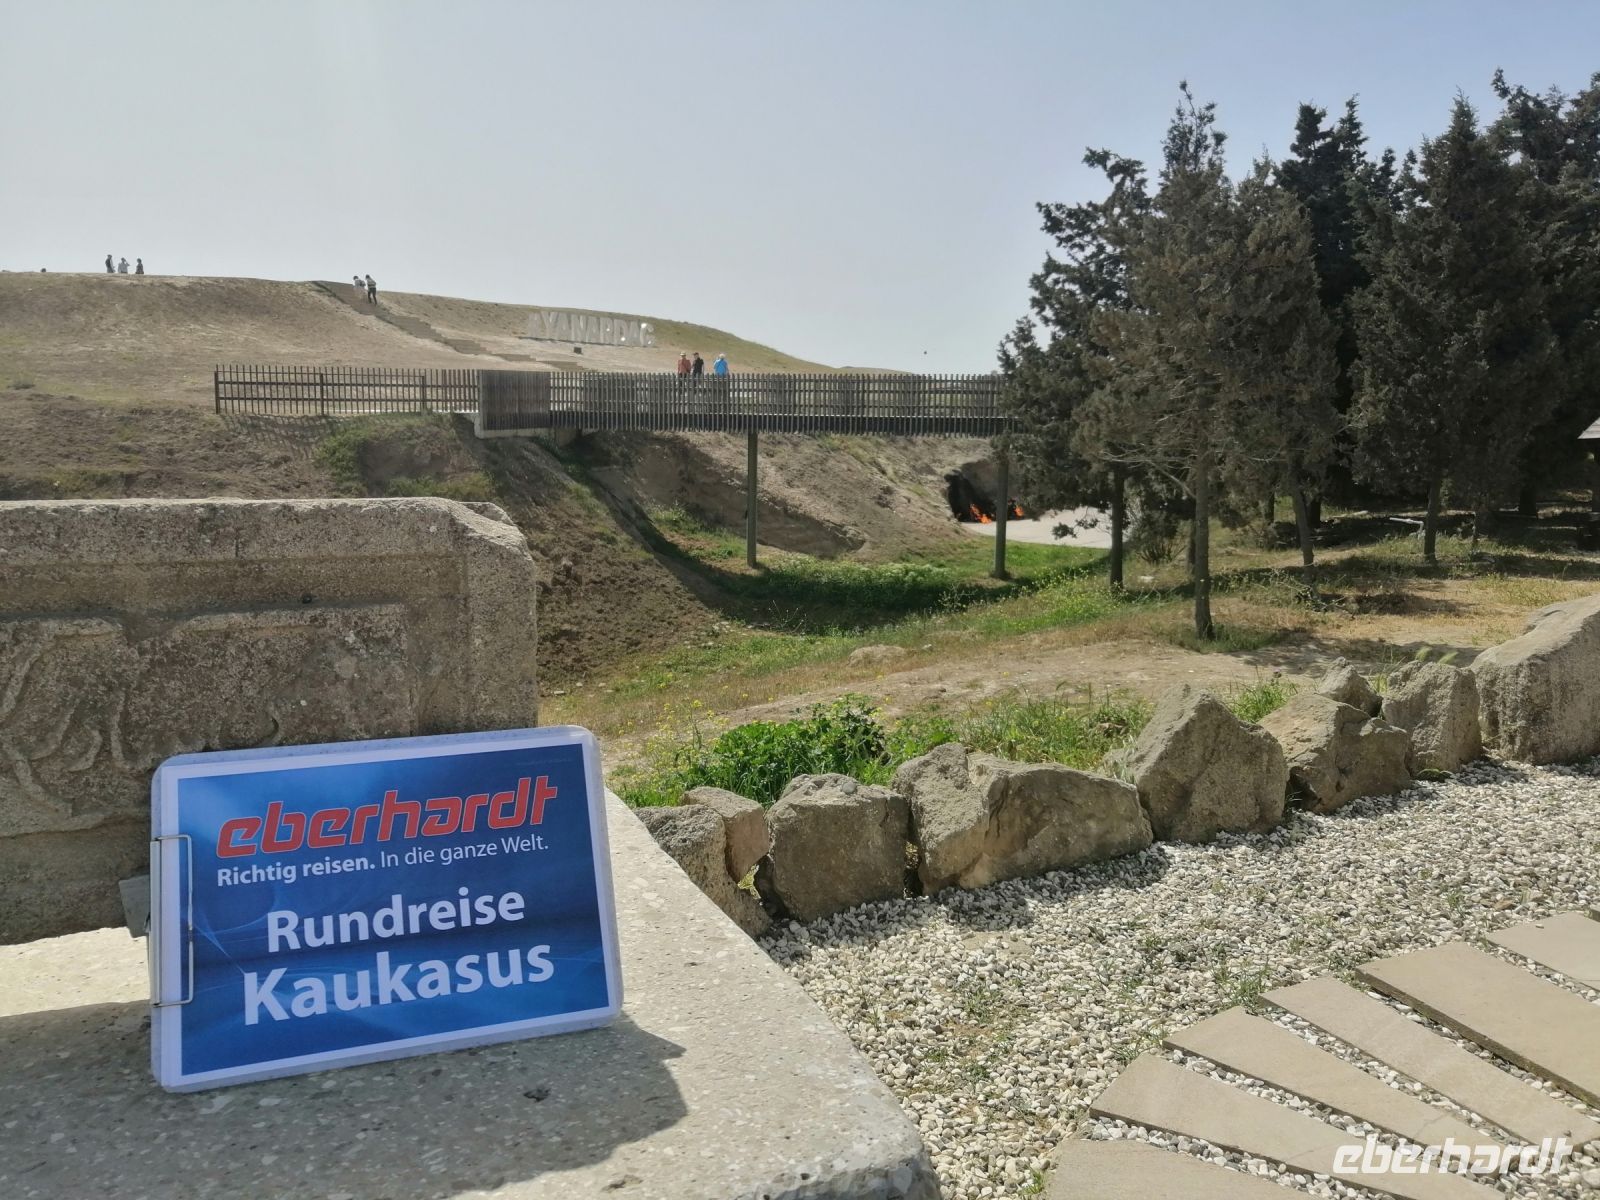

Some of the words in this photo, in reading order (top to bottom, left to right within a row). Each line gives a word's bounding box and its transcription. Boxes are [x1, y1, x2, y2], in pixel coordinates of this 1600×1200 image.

[216, 775, 558, 859] eberhardt
[217, 862, 297, 886] Richtig
[303, 856, 376, 876] reisen.
[381, 851, 399, 868] In
[404, 847, 435, 865] die
[440, 843, 498, 865] ganze
[501, 833, 549, 853] Welt.
[267, 887, 525, 953] Rundreise
[243, 943, 555, 1026] Kaukasus
